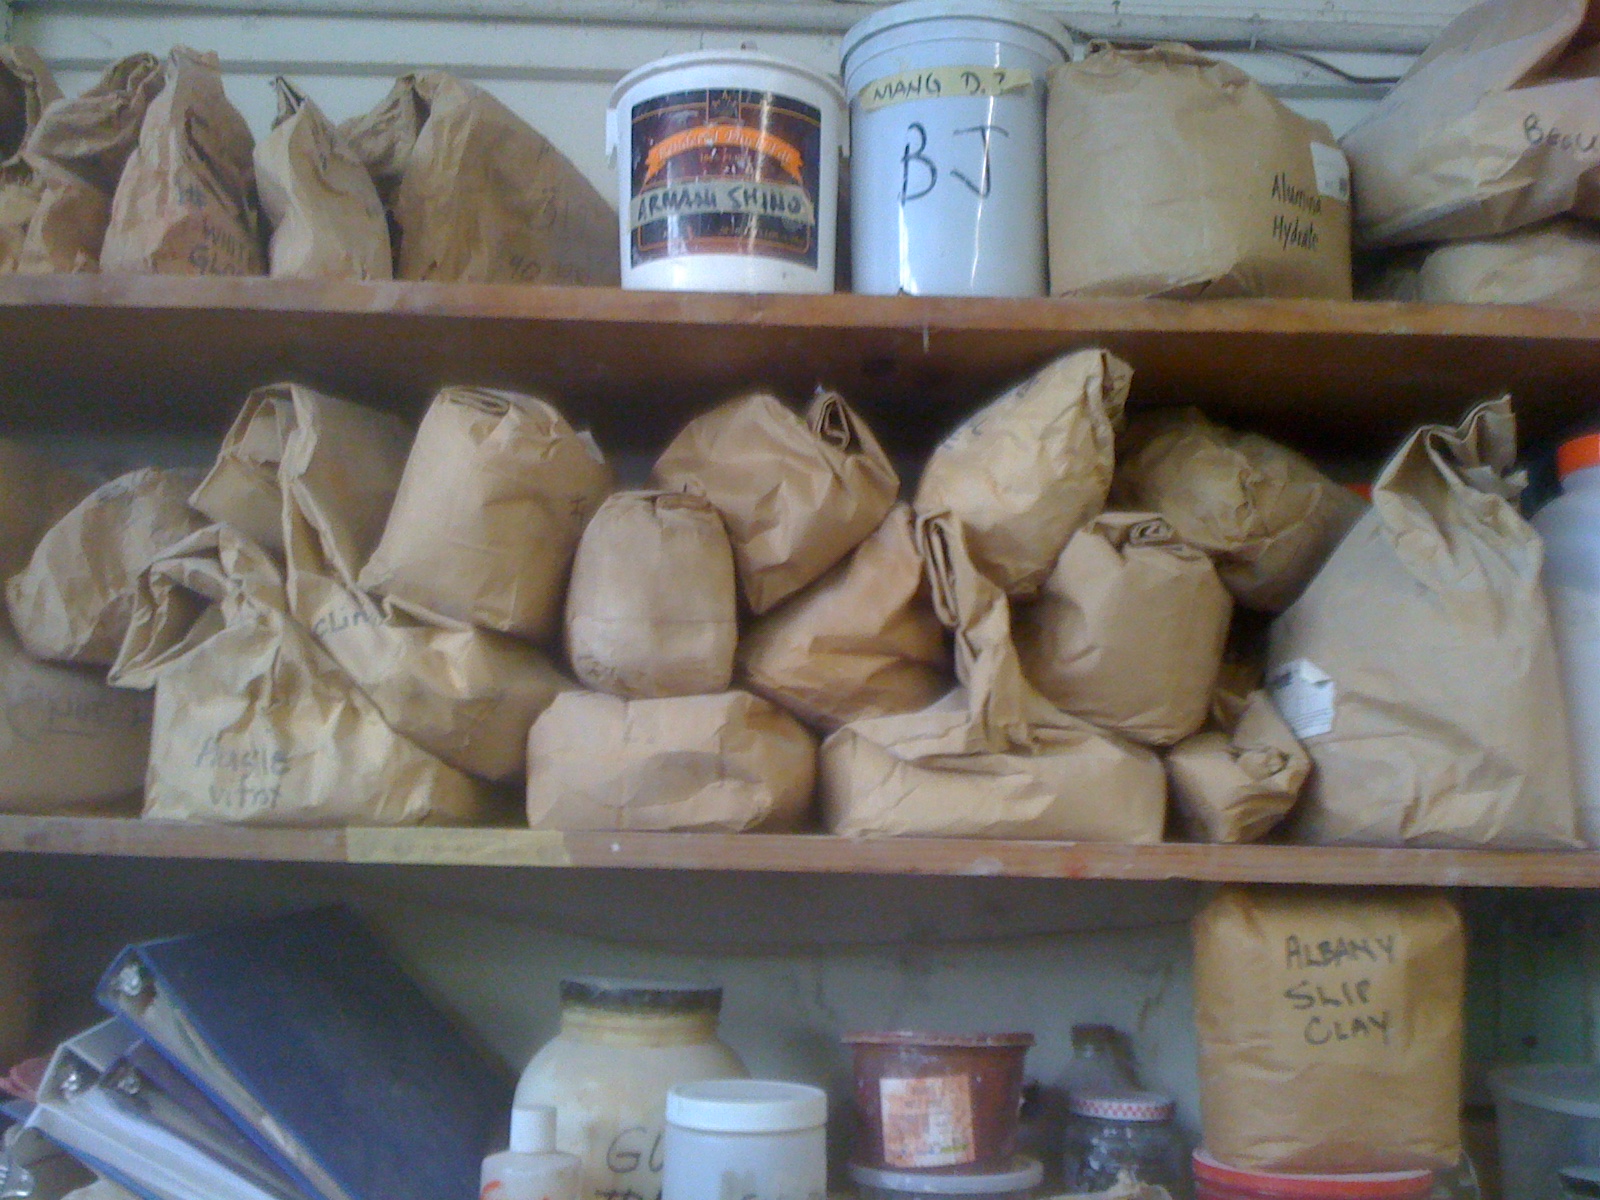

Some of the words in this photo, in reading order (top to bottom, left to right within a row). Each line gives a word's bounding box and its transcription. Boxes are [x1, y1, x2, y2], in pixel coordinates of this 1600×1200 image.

[1285, 934, 1396, 969] ALBANY
[1284, 979, 1371, 1010] SLIP
[1304, 1009, 1390, 1046] CLAY
